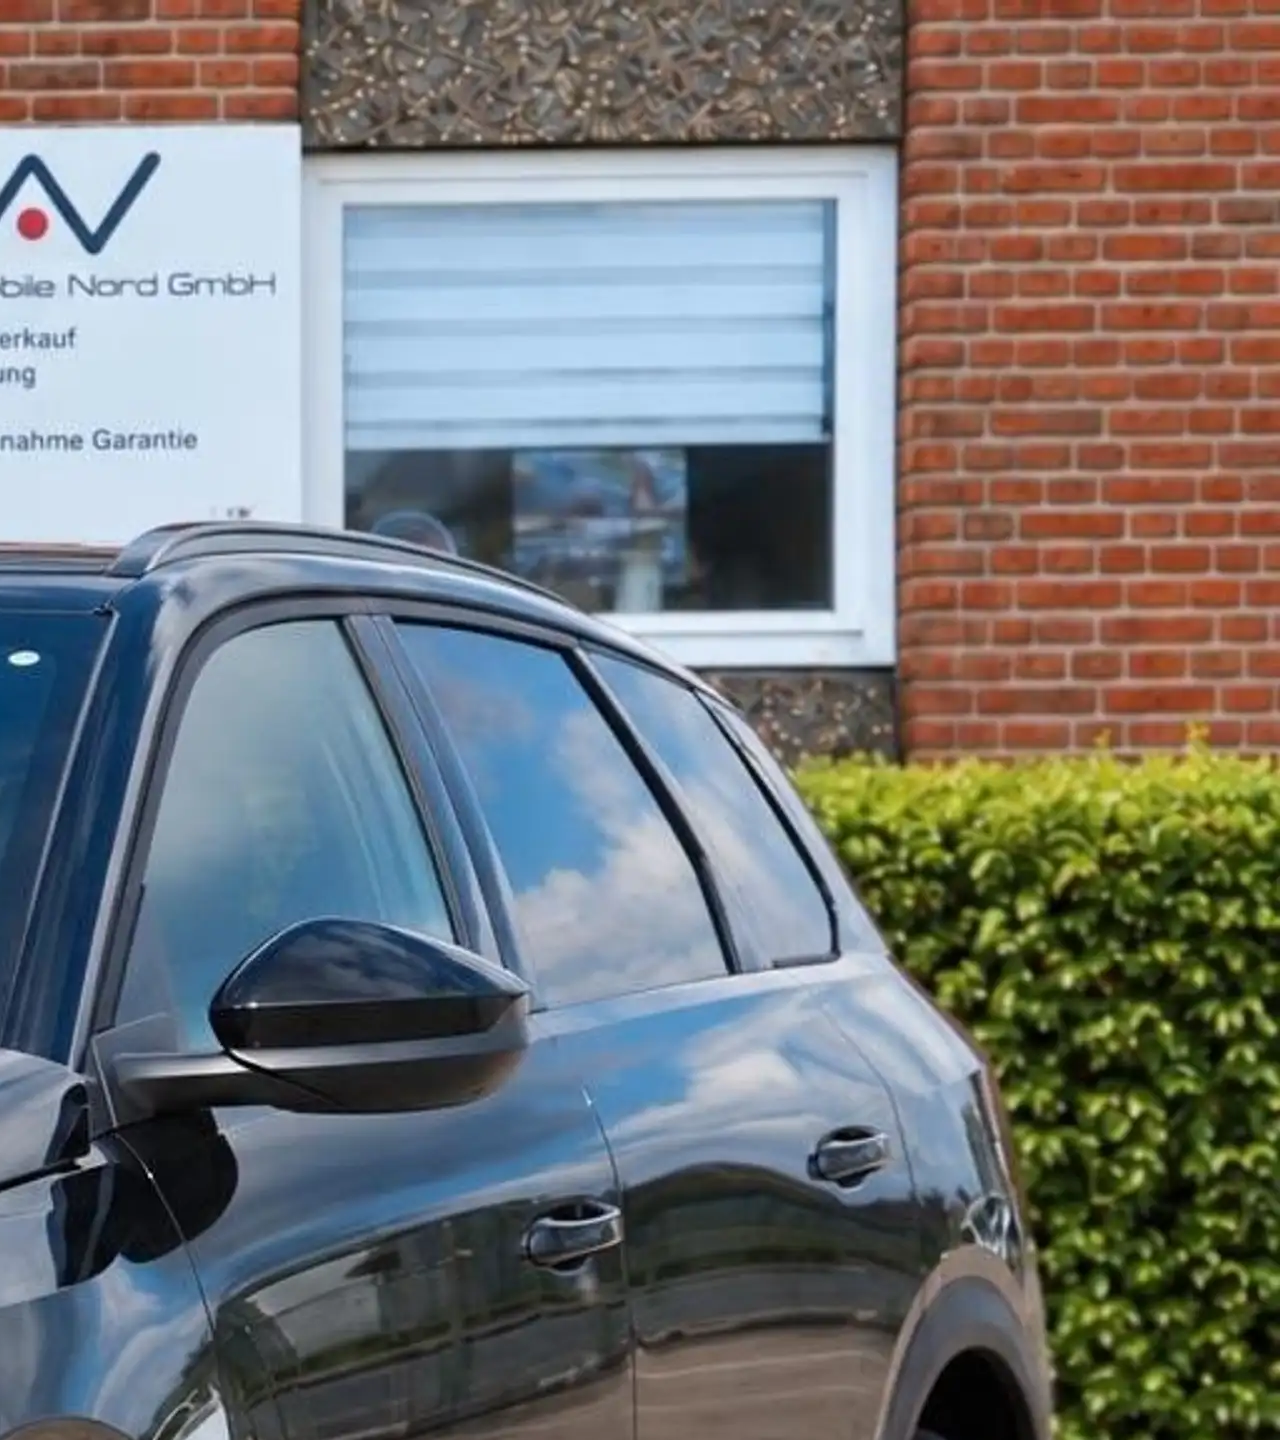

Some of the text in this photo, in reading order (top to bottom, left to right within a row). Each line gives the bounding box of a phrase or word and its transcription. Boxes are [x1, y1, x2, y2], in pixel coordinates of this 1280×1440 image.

[68, 273, 159, 297] Nord
[167, 272, 276, 296] GmbH
[92, 428, 198, 451] Garantie
